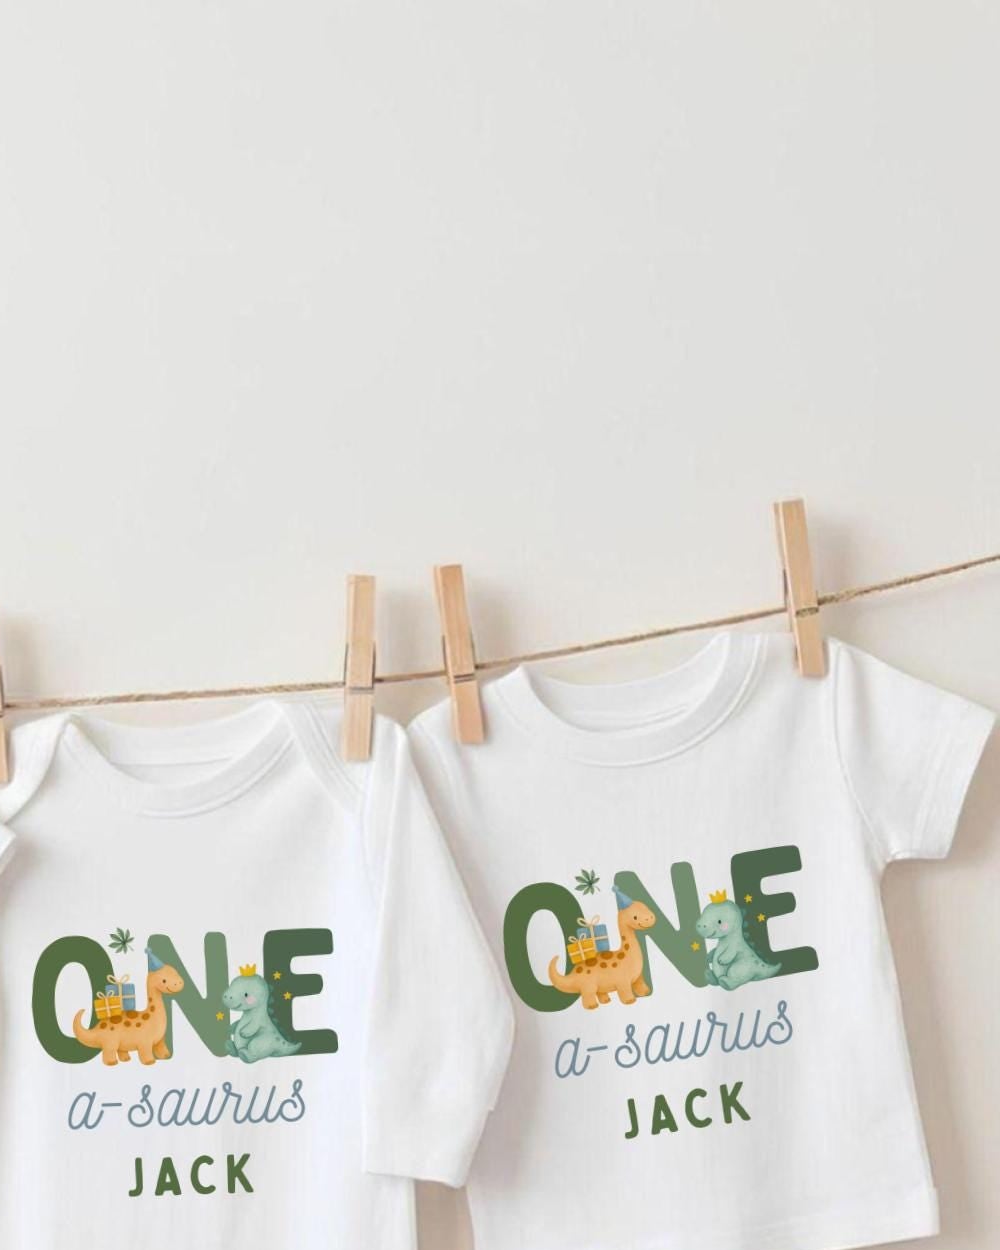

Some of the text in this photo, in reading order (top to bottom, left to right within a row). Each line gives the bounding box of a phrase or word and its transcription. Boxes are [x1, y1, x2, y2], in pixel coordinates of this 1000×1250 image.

[503, 845, 819, 1012] ONE
[32, 928, 338, 1065] ONE
[555, 1000, 793, 1078] a-saurus
[68, 1078, 305, 1130] a-saurus
[625, 1080, 751, 1139] JACK
[129, 1153, 254, 1198] JACK
